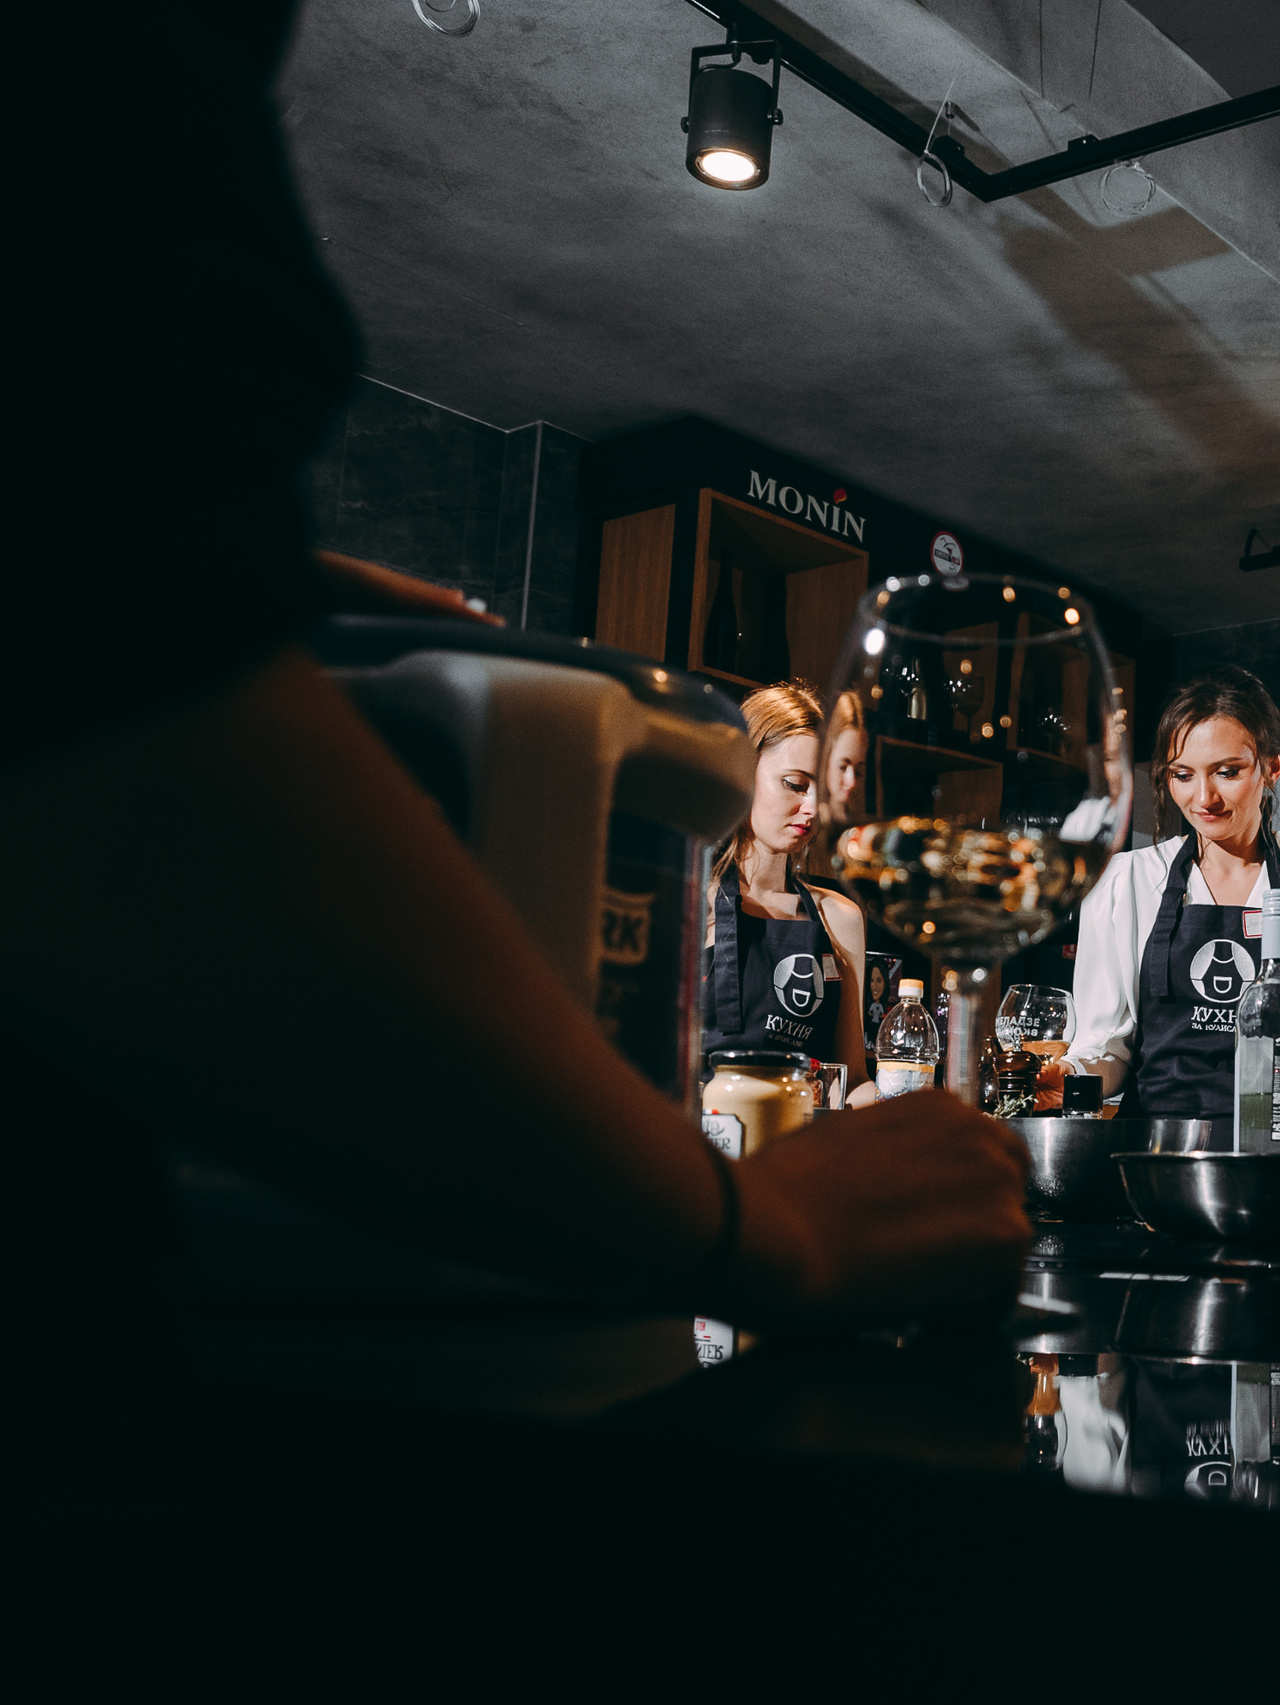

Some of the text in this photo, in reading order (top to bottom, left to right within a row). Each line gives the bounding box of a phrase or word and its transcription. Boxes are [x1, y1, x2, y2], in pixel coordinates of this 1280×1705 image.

[747, 469, 866, 543] MONIN
[765, 1014, 813, 1039] КУХНЯ
[1191, 1022, 1202, 1030] ЗА
